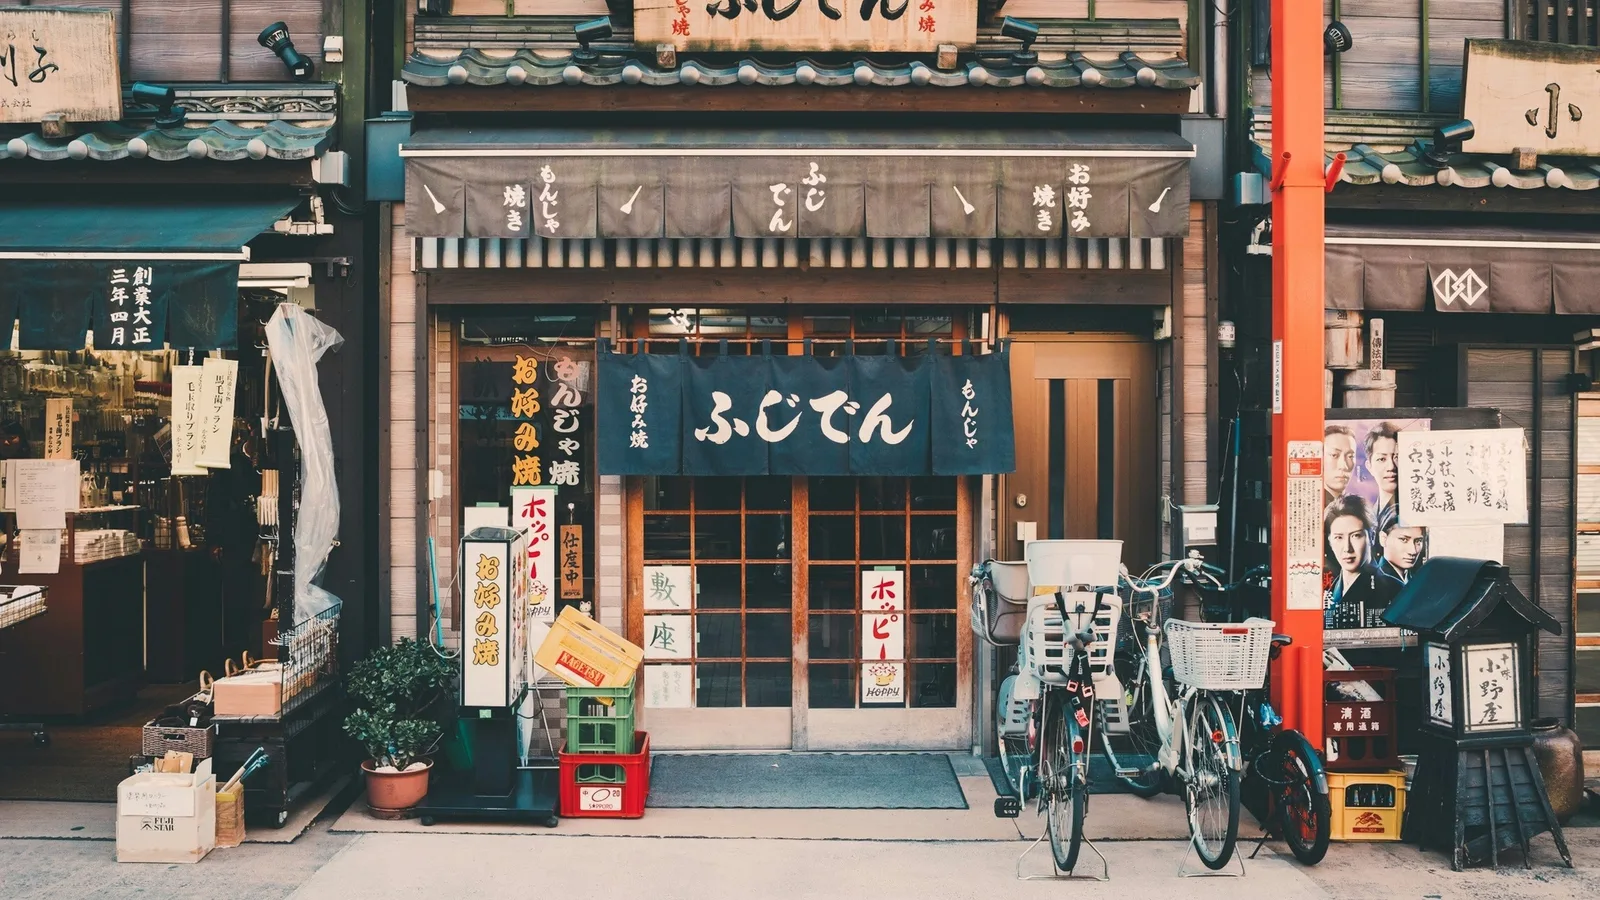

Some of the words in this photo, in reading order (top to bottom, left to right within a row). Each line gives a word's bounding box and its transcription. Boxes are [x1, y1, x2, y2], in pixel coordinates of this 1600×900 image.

[503, 184, 525, 232] 焼き
[539, 164, 560, 234] もんじゃ
[769, 183, 792, 232] でん
[802, 161, 826, 212] ふじ
[1033, 184, 1055, 231] 焼き
[1067, 163, 1092, 232] お好み
[110, 268, 130, 346] 三年四月
[132, 266, 152, 344] 創業大正
[511, 354, 542, 486] お好み焼
[629, 373, 649, 450] お好み焼
[694, 389, 914, 445] ふじでん
[961, 378, 979, 450] もんじゃ
[563, 531, 580, 586] 仕度中
[473, 553, 501, 666] お好み焼
[650, 621, 678, 653] 座
[870, 576, 898, 660] ホッピー
[1341, 707, 1372, 719] 清酒
[1433, 655, 1446, 717] 小野屋
[1479, 657, 1504, 724] 小野屋
[154, 824, 174, 832] STAR
